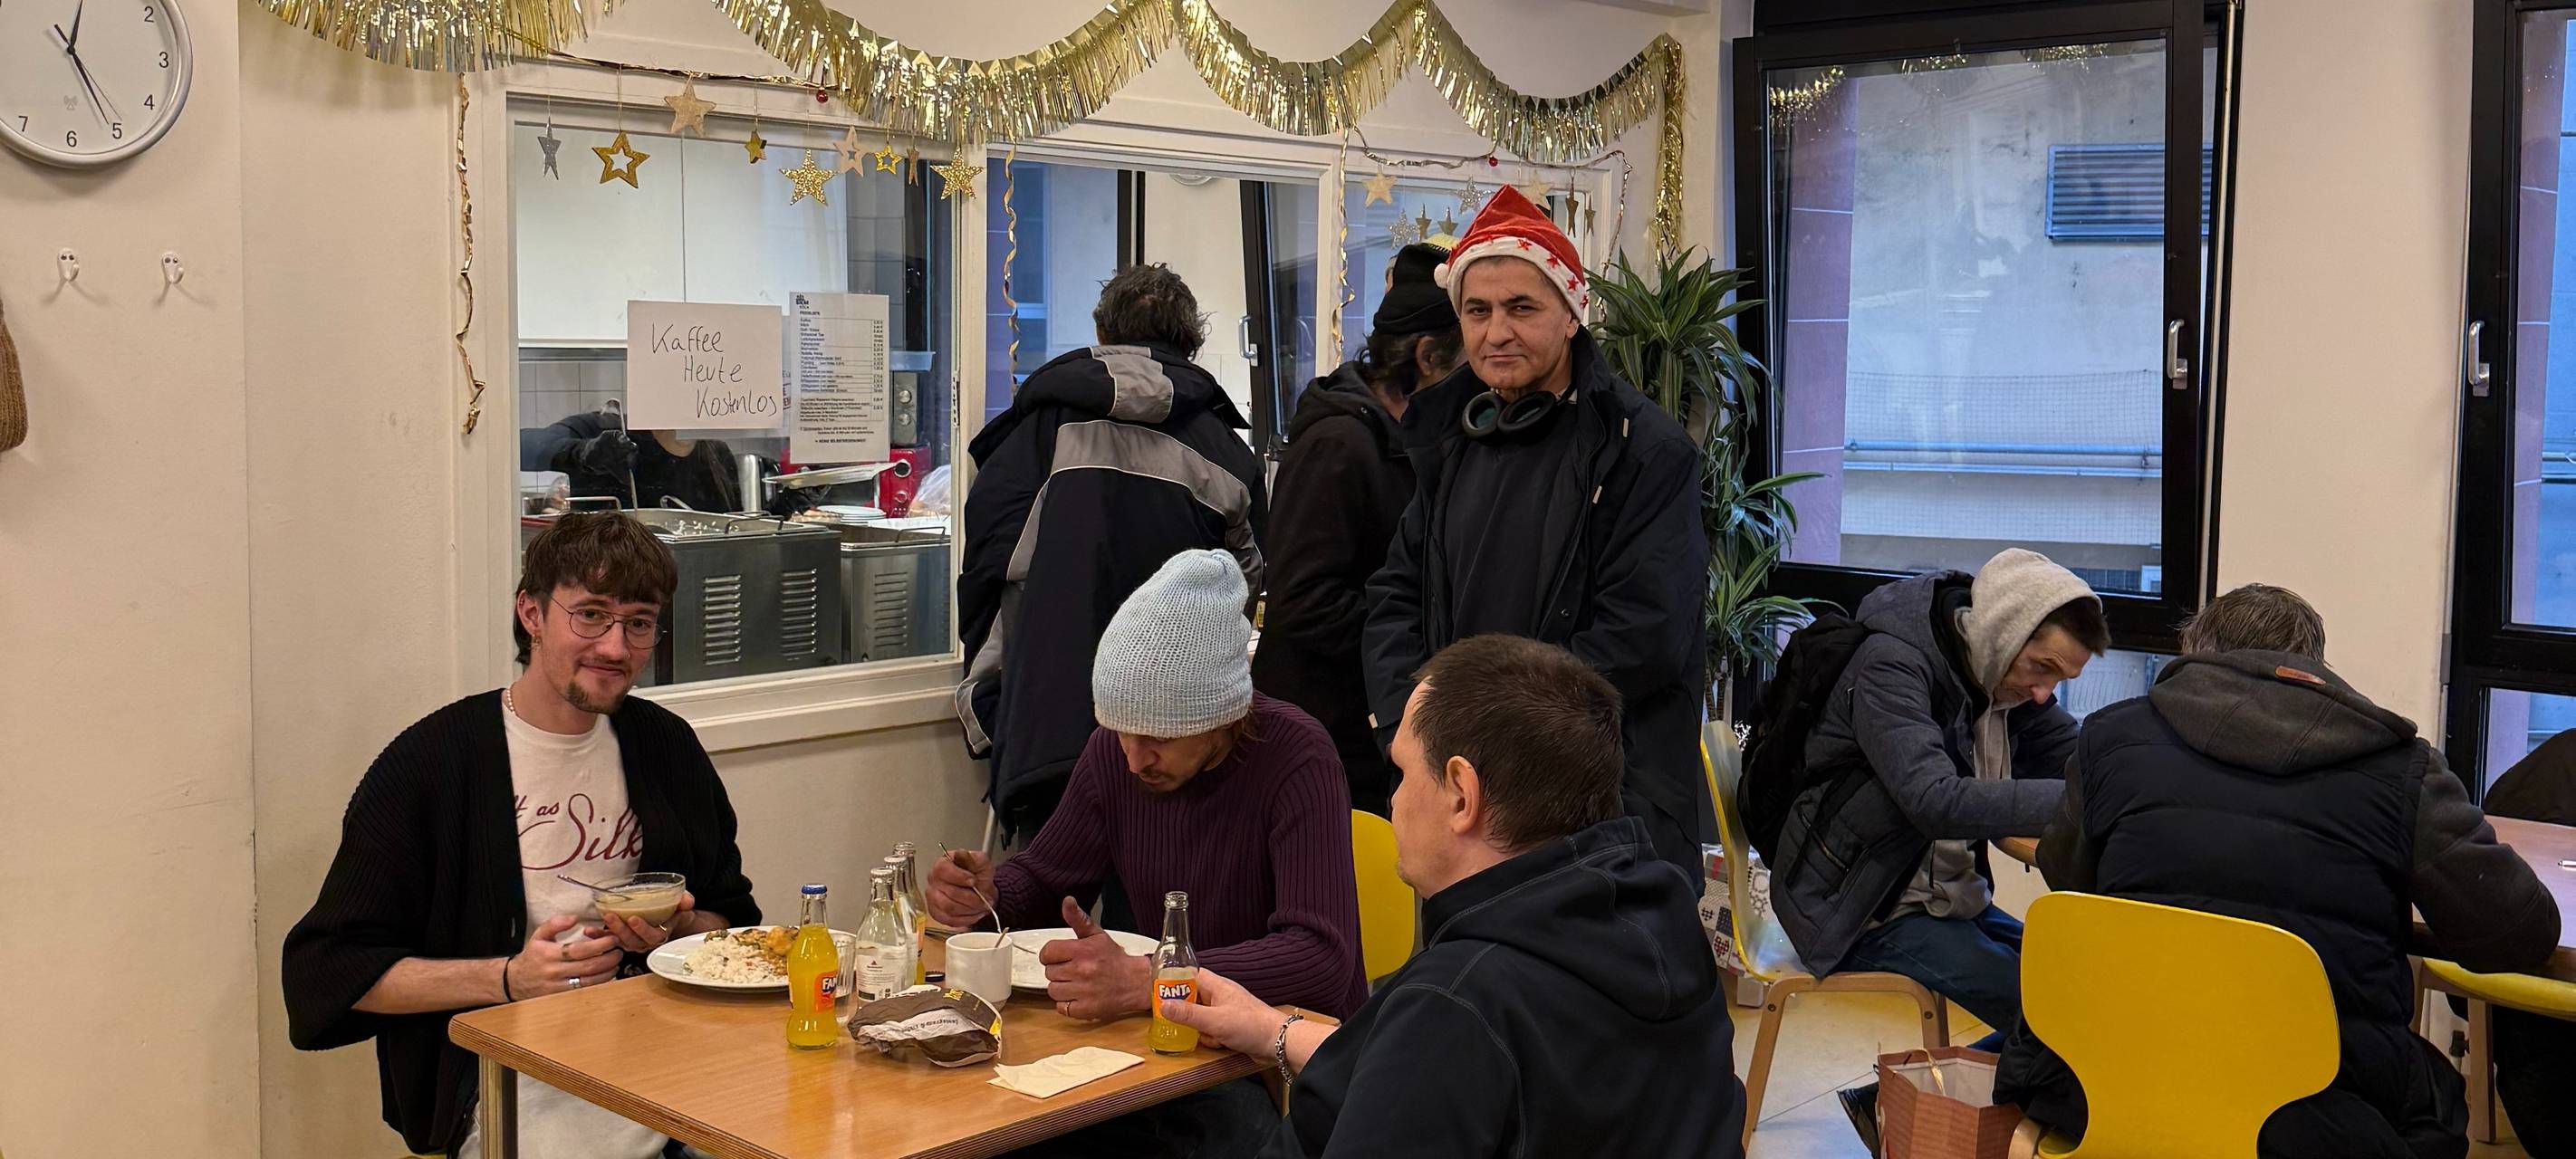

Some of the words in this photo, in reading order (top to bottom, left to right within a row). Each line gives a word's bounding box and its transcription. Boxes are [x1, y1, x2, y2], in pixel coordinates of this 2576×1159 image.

[144, 5, 155, 23] 2
[159, 51, 169, 68] 3
[143, 94, 155, 110] 4
[18, 115, 28, 132] 7
[111, 122, 122, 139] 5
[66, 130, 77, 148] 6
[652, 322, 725, 354] Kaffee
[684, 354, 743, 384] Heute
[697, 386, 777, 418] Kostenlos
[536, 801, 560, 816] as
[521, 793, 643, 870] Silk
[1158, 983, 1191, 998] FANTA
